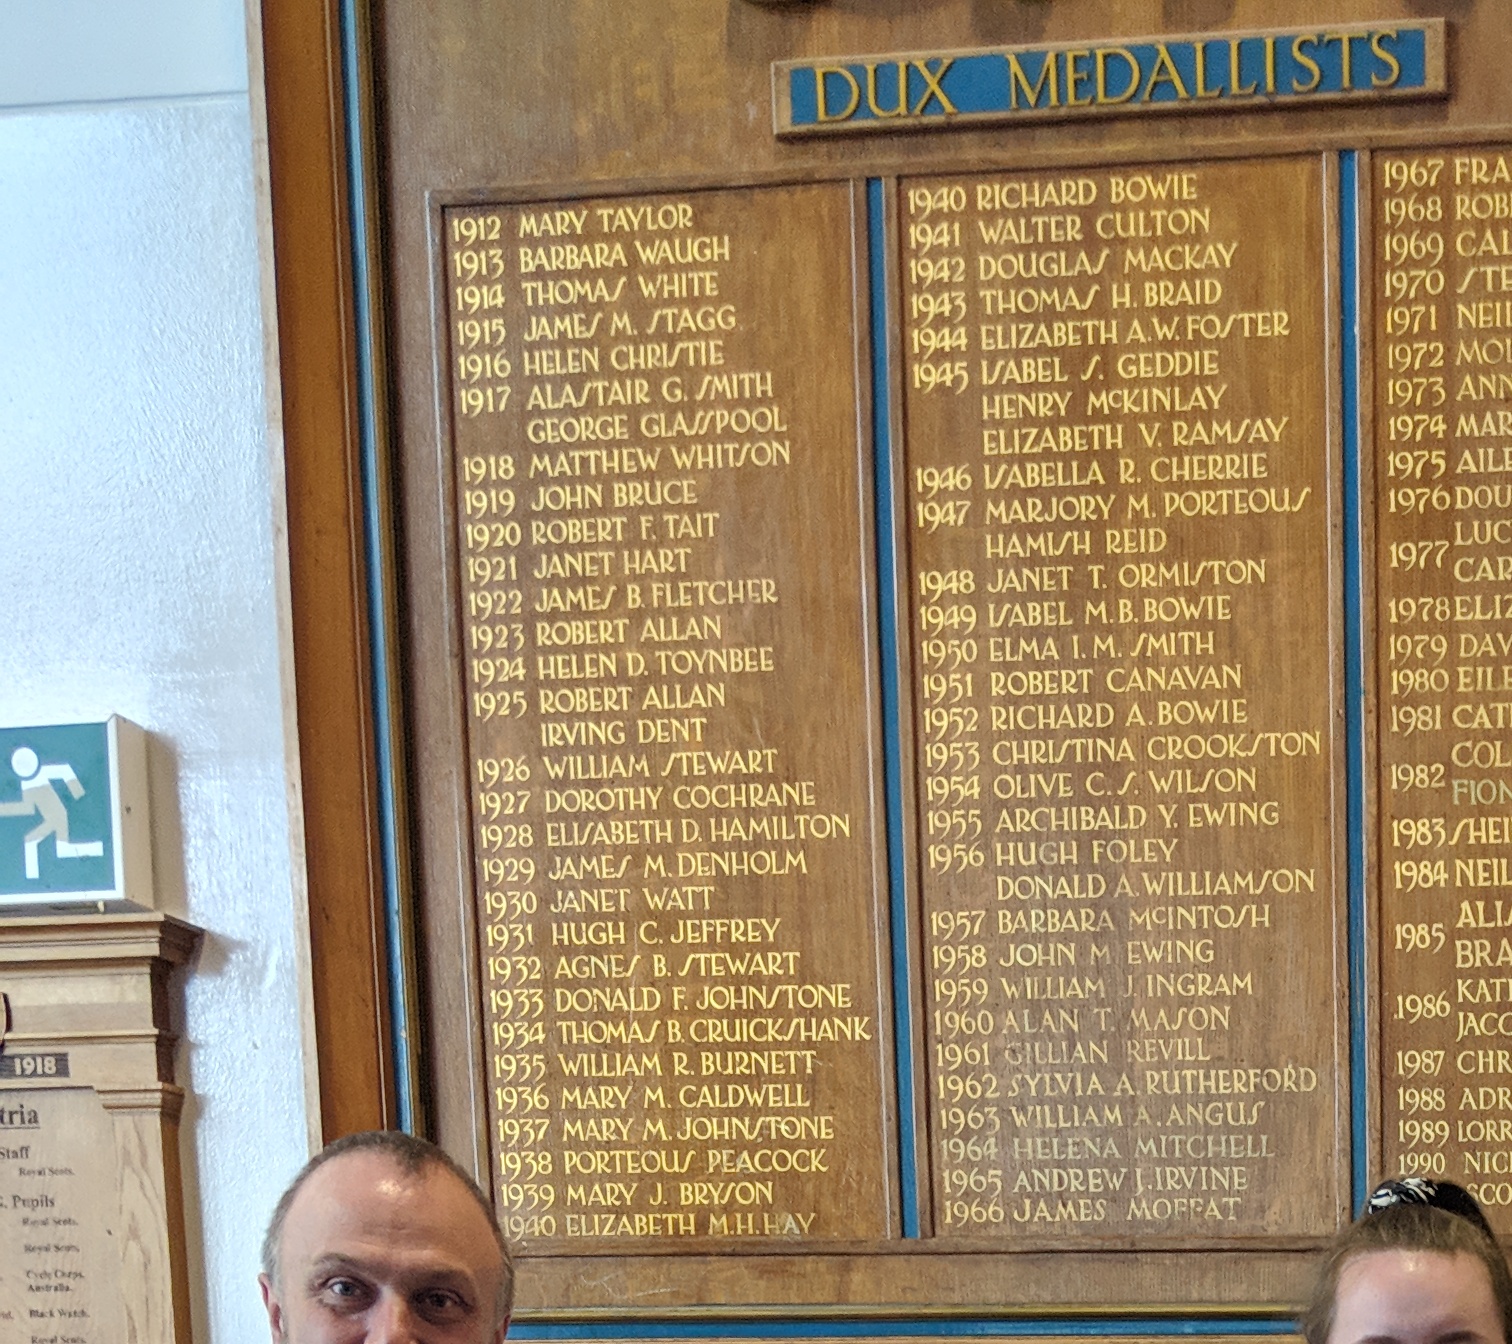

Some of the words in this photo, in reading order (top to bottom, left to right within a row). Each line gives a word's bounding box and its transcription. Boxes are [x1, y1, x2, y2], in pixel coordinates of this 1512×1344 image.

[815, 57, 958, 122] DUX
[1006, 30, 1400, 108] MEDALLISTS
[1384, 157, 1444, 193] 1967
[908, 185, 966, 220] 1940
[976, 178, 1097, 210] RICHARD
[1110, 172, 1198, 203] BOWIE
[1385, 194, 1442, 227] 1968
[452, 215, 501, 246] 1912
[519, 208, 588, 238] MARY
[596, 202, 692, 232] TAYLOR
[909, 221, 960, 255] 1941
[978, 215, 1083, 245] WALTER
[1096, 206, 1210, 238] CULTON
[453, 248, 504, 281] 1913
[519, 242, 627, 273] BARBARA
[634, 235, 730, 265] WAUGH
[458, 349, 511, 383] 1916
[523, 346, 599, 376] HELEN
[610, 339, 724, 371] CHRISTIE
[527, 414, 628, 444] GEORGE
[641, 405, 787, 437] GLASSPOOL
[982, 391, 1072, 420] HENRY
[463, 454, 515, 484] 1918
[529, 447, 661, 478] MATTHEW
[670, 440, 790, 469] WHITSON
[464, 488, 515, 519] 1919
[531, 483, 602, 511] JOHN
[613, 477, 697, 507] BRUCE
[985, 530, 1090, 559] HAMISH
[1106, 527, 1167, 554] REID
[919, 569, 975, 602] 1948
[987, 566, 1073, 593] JANET
[1118, 558, 1266, 588] ORMISTON
[1389, 633, 1447, 665] 1979
[923, 672, 972, 704] 1951
[991, 669, 1093, 696] ROBERT
[1106, 664, 1241, 693] CANAVAN
[477, 755, 530, 789] 1926
[543, 754, 650, 779] WILLIAM
[661, 749, 778, 776] STEWART
[925, 741, 980, 772] 1953
[993, 737, 1136, 765] CHRISTINA
[1148, 730, 1321, 761] CROOKSTON
[479, 791, 531, 820] 1927
[545, 786, 663, 813] DOROTHY
[673, 781, 815, 810] COCHRANE
[928, 842, 984, 875] 1956
[995, 841, 1077, 866] HUGH
[1093, 838, 1178, 863] FOLEY
[1394, 860, 1449, 893] 1984
[484, 891, 537, 922] 1930
[550, 888, 630, 913] JANET
[642, 886, 715, 911] WATT
[14, 1056, 57, 1076] 1918
[1397, 1050, 1445, 1078] 1987
[0, 1104, 39, 1127] tria
[1398, 1086, 1445, 1115] 1988
[12, 1194, 55, 1212] Pupils
